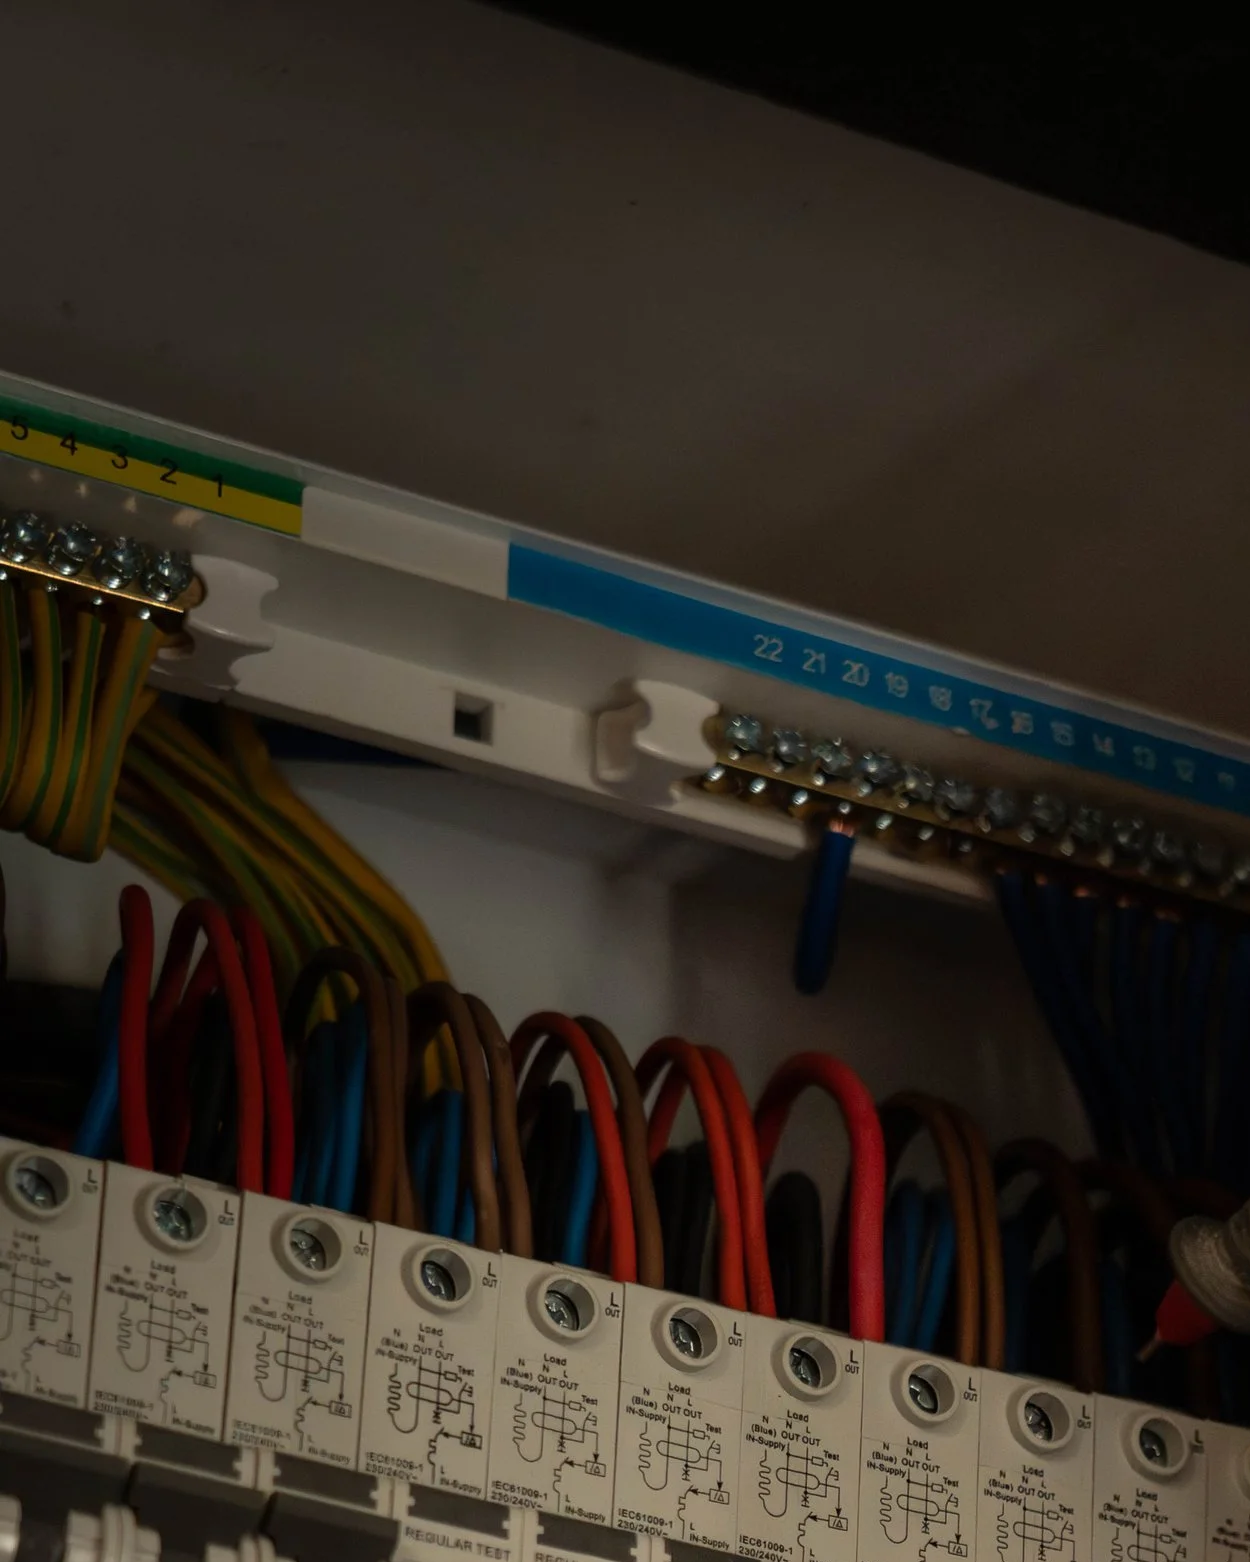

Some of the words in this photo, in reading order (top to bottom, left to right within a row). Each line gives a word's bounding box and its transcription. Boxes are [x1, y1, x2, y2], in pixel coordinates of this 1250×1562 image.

[11, 415, 28, 440] 5
[60, 432, 78, 455] 4
[112, 444, 128, 469] 3
[160, 458, 178, 485] 2
[215, 472, 223, 497] 1
[753, 634, 784, 663] 22
[802, 649, 827, 675] 21
[488, 1262, 497, 1277] L
[611, 1292, 619, 1307] L
[605, 1308, 620, 1318] OUT
[734, 1322, 742, 1336] L
[728, 1337, 743, 1347] OUT
[850, 1350, 858, 1364] L
[845, 1364, 860, 1375] OUT
[668, 1382, 691, 1395] Load
[968, 1377, 976, 1391] L
[964, 1391, 978, 1402] OUT
[662, 1402, 682, 1414] OUT
[683, 1407, 702, 1419] OUT
[787, 1410, 809, 1423] Load
[1082, 1405, 1091, 1419] L
[1077, 1419, 1092, 1430] OUT
[781, 1430, 800, 1442] OUT
[802, 1435, 821, 1447] OUT
[907, 1437, 928, 1450] Load
[901, 1457, 920, 1469] OUT
[922, 1462, 941, 1474] OUT
[405, 1527, 472, 1552] REGULAR
[477, 1543, 511, 1562] TEST
